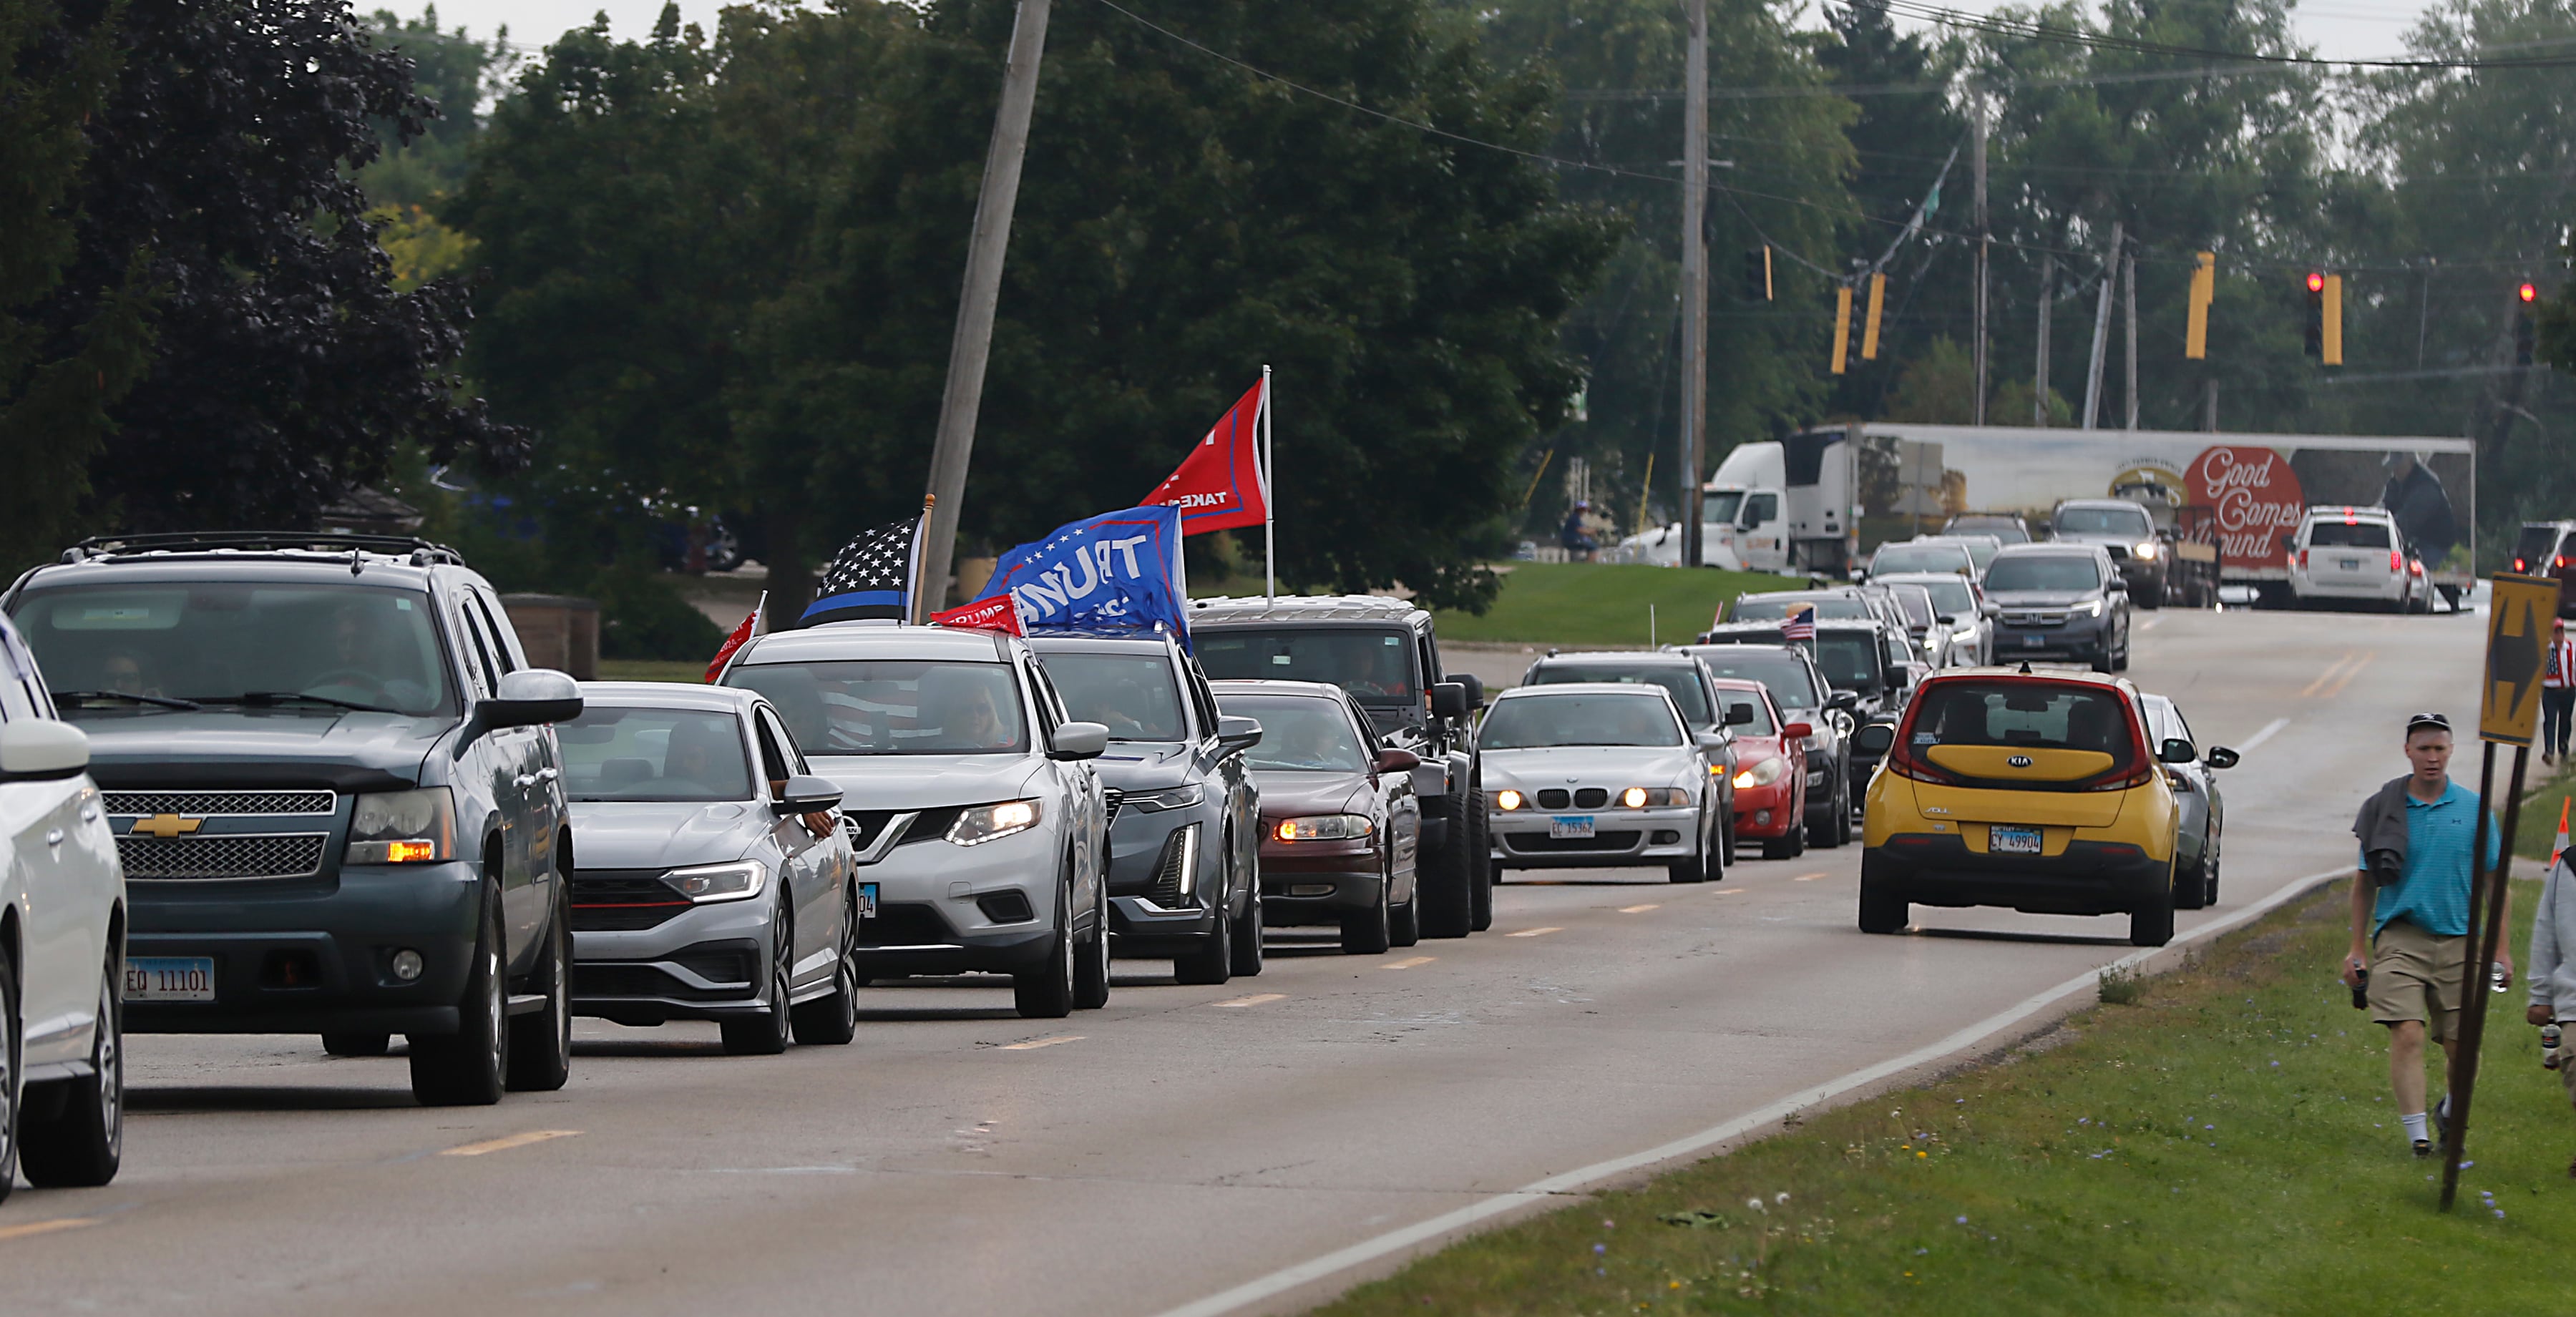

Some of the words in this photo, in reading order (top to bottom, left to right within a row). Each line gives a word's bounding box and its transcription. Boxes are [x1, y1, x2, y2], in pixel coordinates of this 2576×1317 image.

[2203, 447, 2273, 498] Good
[2219, 487, 2301, 532] Comes
[2186, 518, 2272, 558] Aound
[2011, 757, 2029, 765] KIA
[1991, 834, 2003, 847] CY
[2009, 835, 2039, 849] 49904
[127, 970, 147, 992] EQ
[158, 970, 209, 992] 11101
